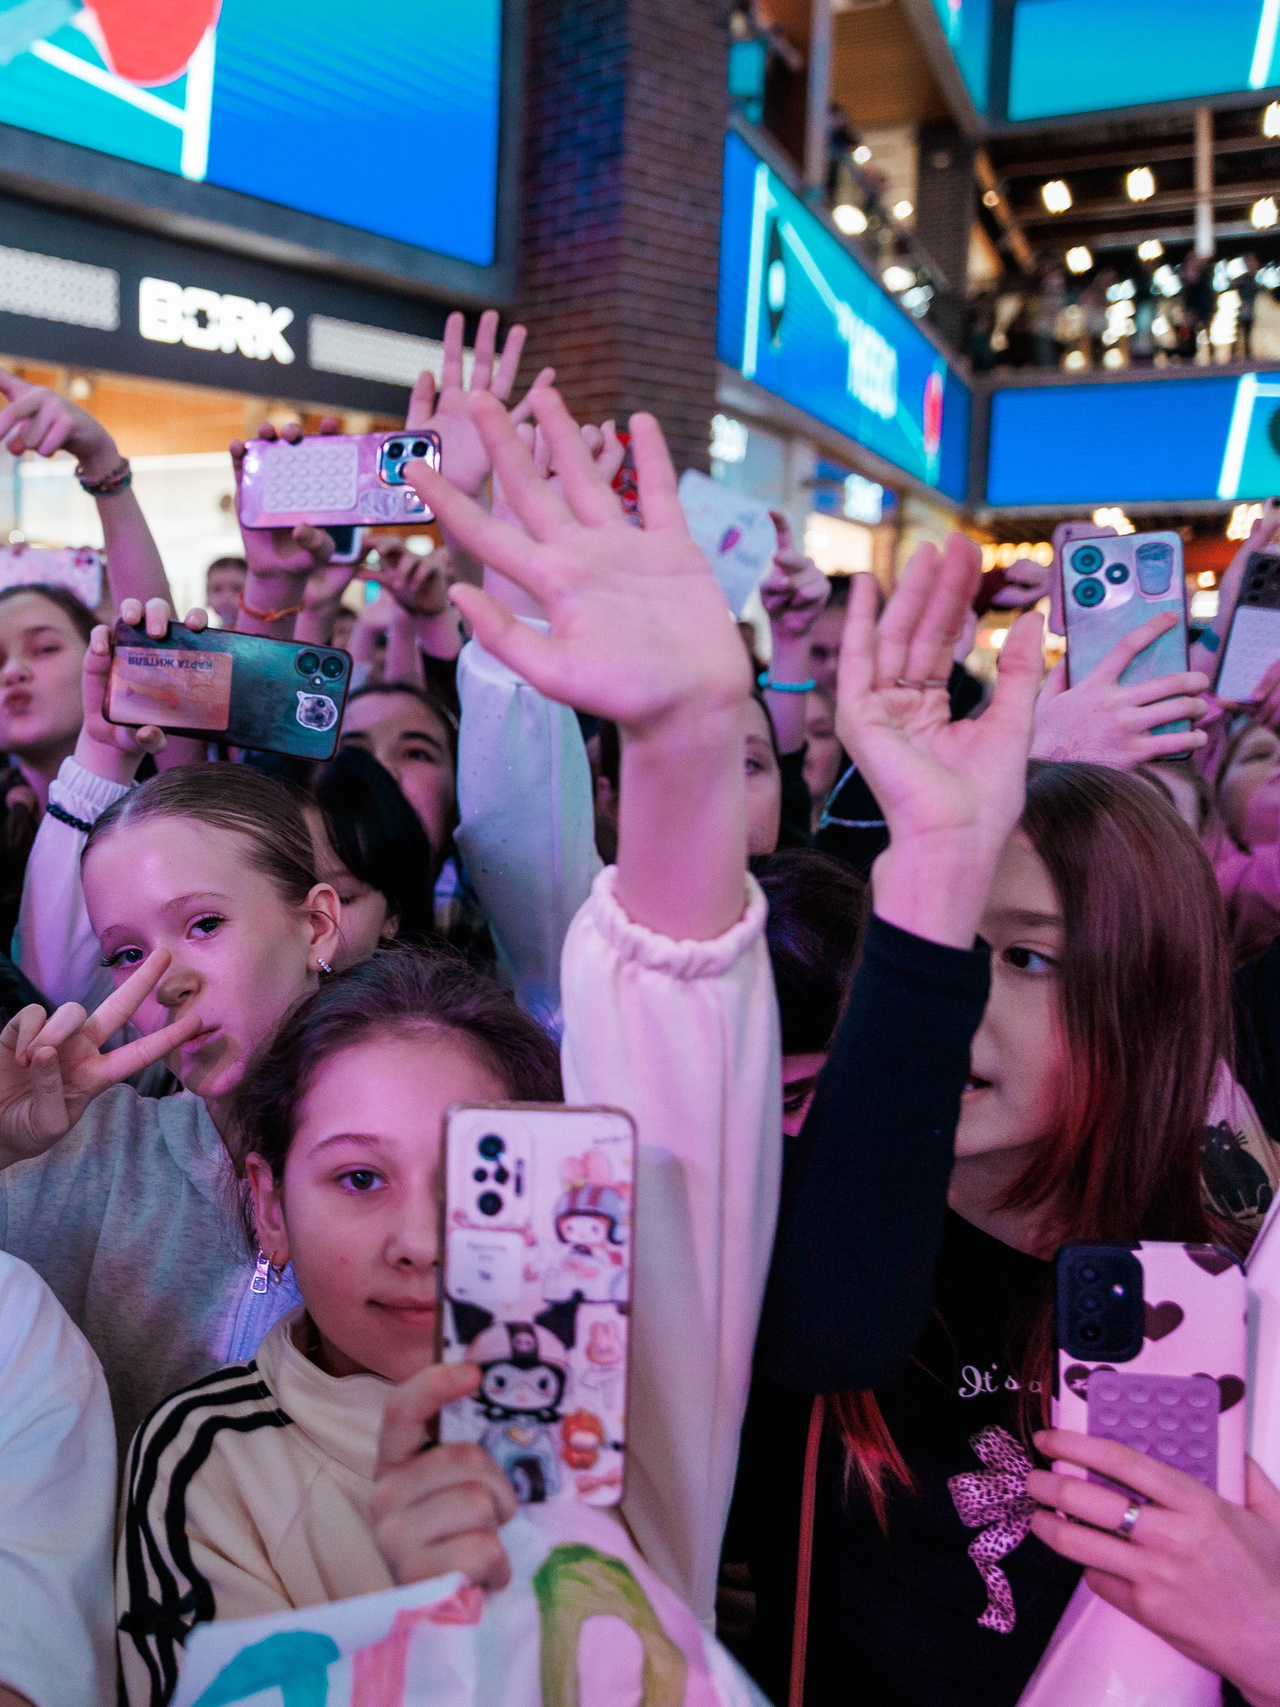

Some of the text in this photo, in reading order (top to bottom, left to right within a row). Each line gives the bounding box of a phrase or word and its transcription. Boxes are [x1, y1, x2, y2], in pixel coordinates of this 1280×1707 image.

[138, 277, 294, 364] BORK
[127, 656, 213, 670] КАРТА ЖИТЕЛЯ
[958, 1362, 1022, 1398] It's
